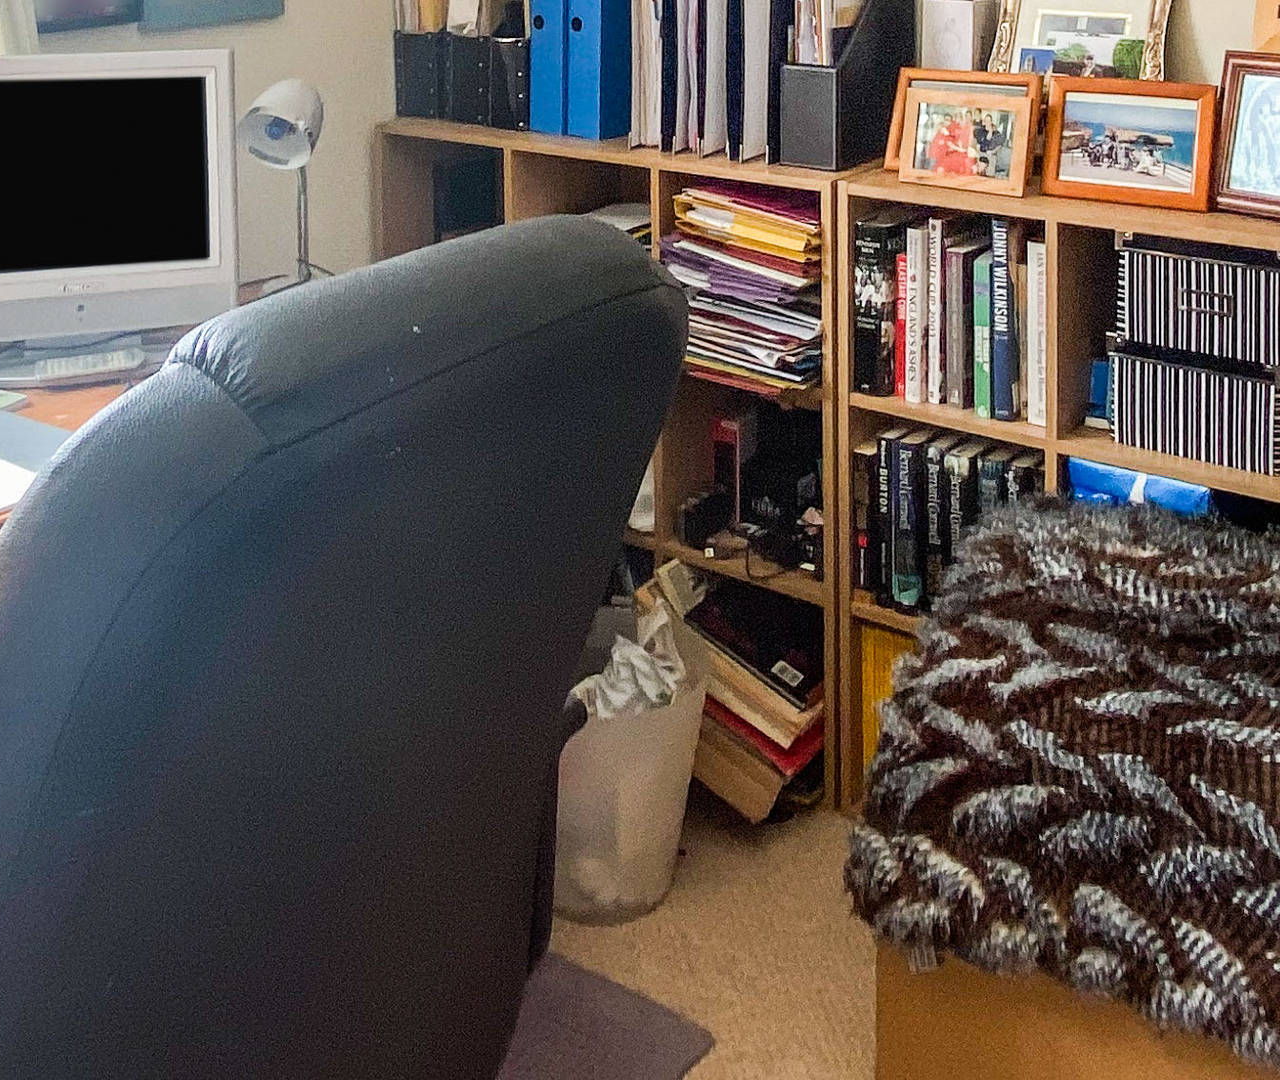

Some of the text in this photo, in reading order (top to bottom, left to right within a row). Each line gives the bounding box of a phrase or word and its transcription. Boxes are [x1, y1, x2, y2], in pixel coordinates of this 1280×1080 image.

[928, 235, 937, 278] WORLD
[928, 281, 937, 307] CUP
[992, 225, 1009, 332] JONNY WILKINSON
[907, 287, 918, 382] ENGLAND'S ASHES
[879, 468, 888, 514] BURTON
[898, 449, 913, 491] Bernard
[927, 463, 940, 503] Bernard
